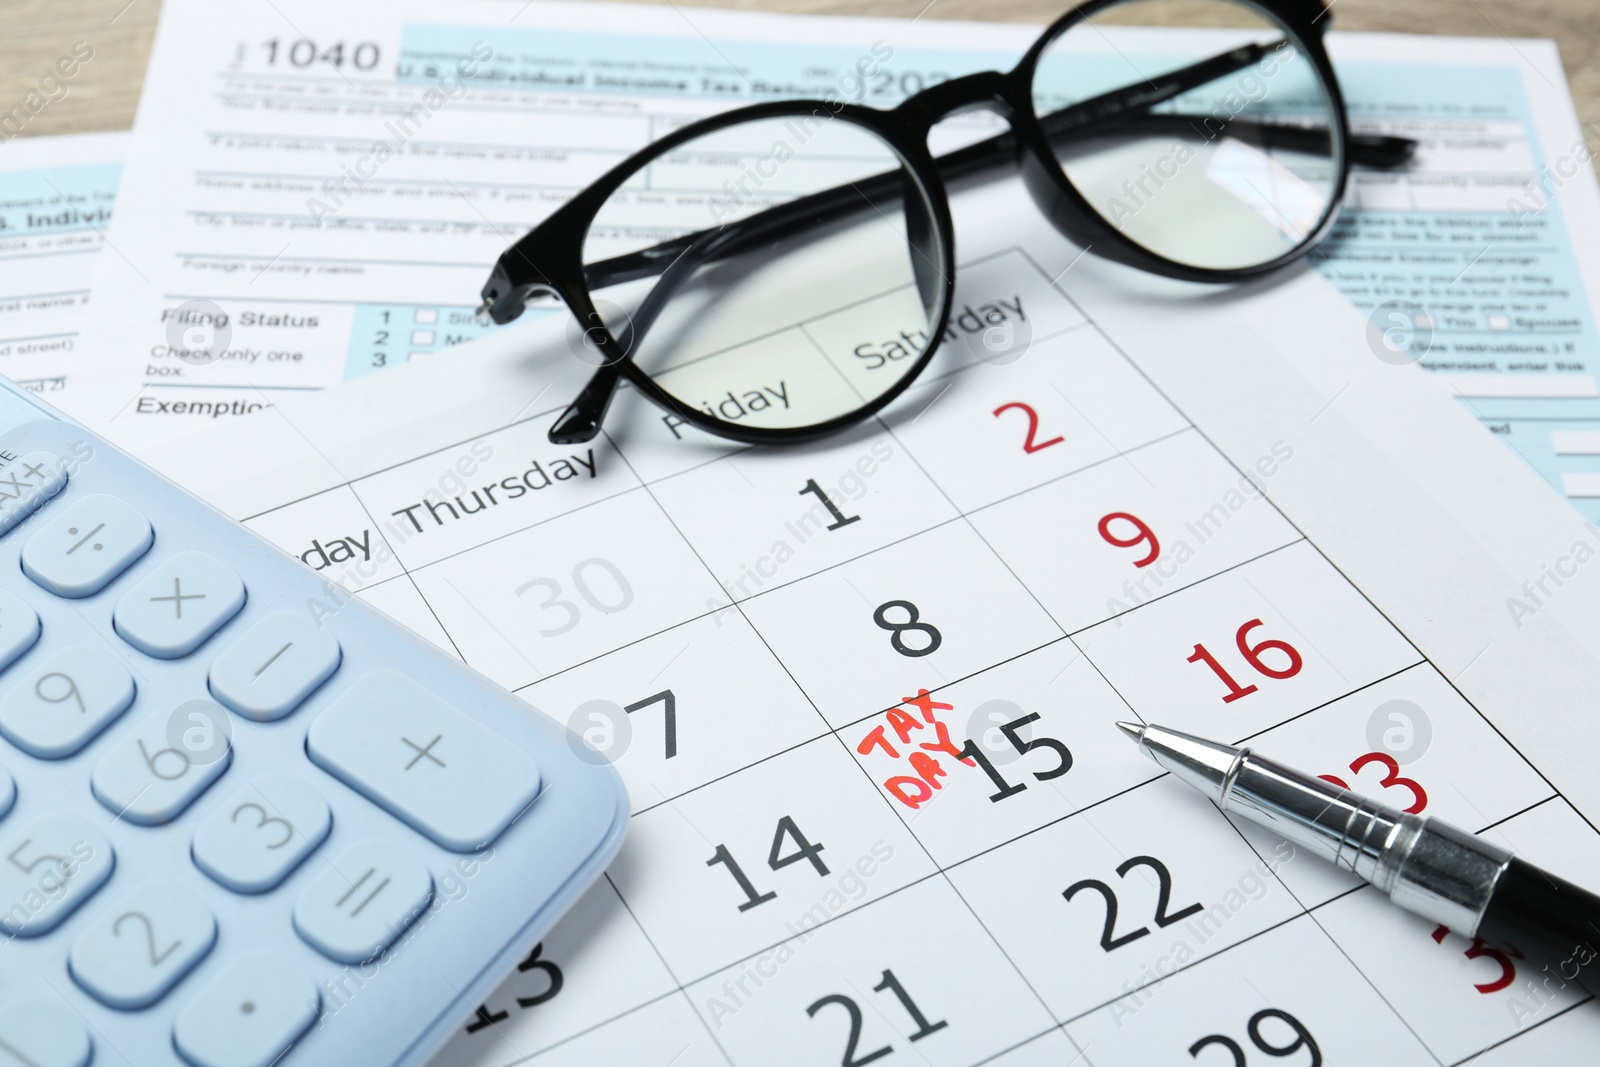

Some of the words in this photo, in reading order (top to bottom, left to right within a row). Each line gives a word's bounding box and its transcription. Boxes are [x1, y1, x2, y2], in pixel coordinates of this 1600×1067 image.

[260, 36, 381, 72] 1040
[182, 258, 245, 272] Foreign
[251, 261, 313, 275] country
[316, 263, 365, 275] name
[161, 307, 230, 328] Filing
[238, 310, 320, 327] Status
[373, 330, 390, 346] 2
[150, 344, 213, 361] Check
[219, 348, 261, 364] only
[266, 350, 304, 362] one
[371, 352, 387, 367] 3
[295, 529, 371, 571] day
[391, 448, 597, 533] Thursday
[661, 380, 790, 440] Fiday
[513, 556, 634, 638] 30
[798, 478, 862, 532] 1
[991, 401, 1066, 454] 2
[622, 689, 678, 760] 7
[873, 600, 942, 657] 8
[1097, 511, 1161, 569] 9
[35, 672, 87, 714] 9
[856, 688, 954, 759] TAX
[137, 738, 190, 781] 6
[705, 814, 831, 913] 14
[955, 711, 1074, 804] 15
[1186, 618, 1303, 704] 16
[883, 720, 977, 809] DAY
[230, 802, 294, 850] 3
[7, 838, 74, 895] 5
[112, 911, 184, 968] 2
[805, 968, 949, 1067] 21
[1062, 855, 1205, 953] 22
